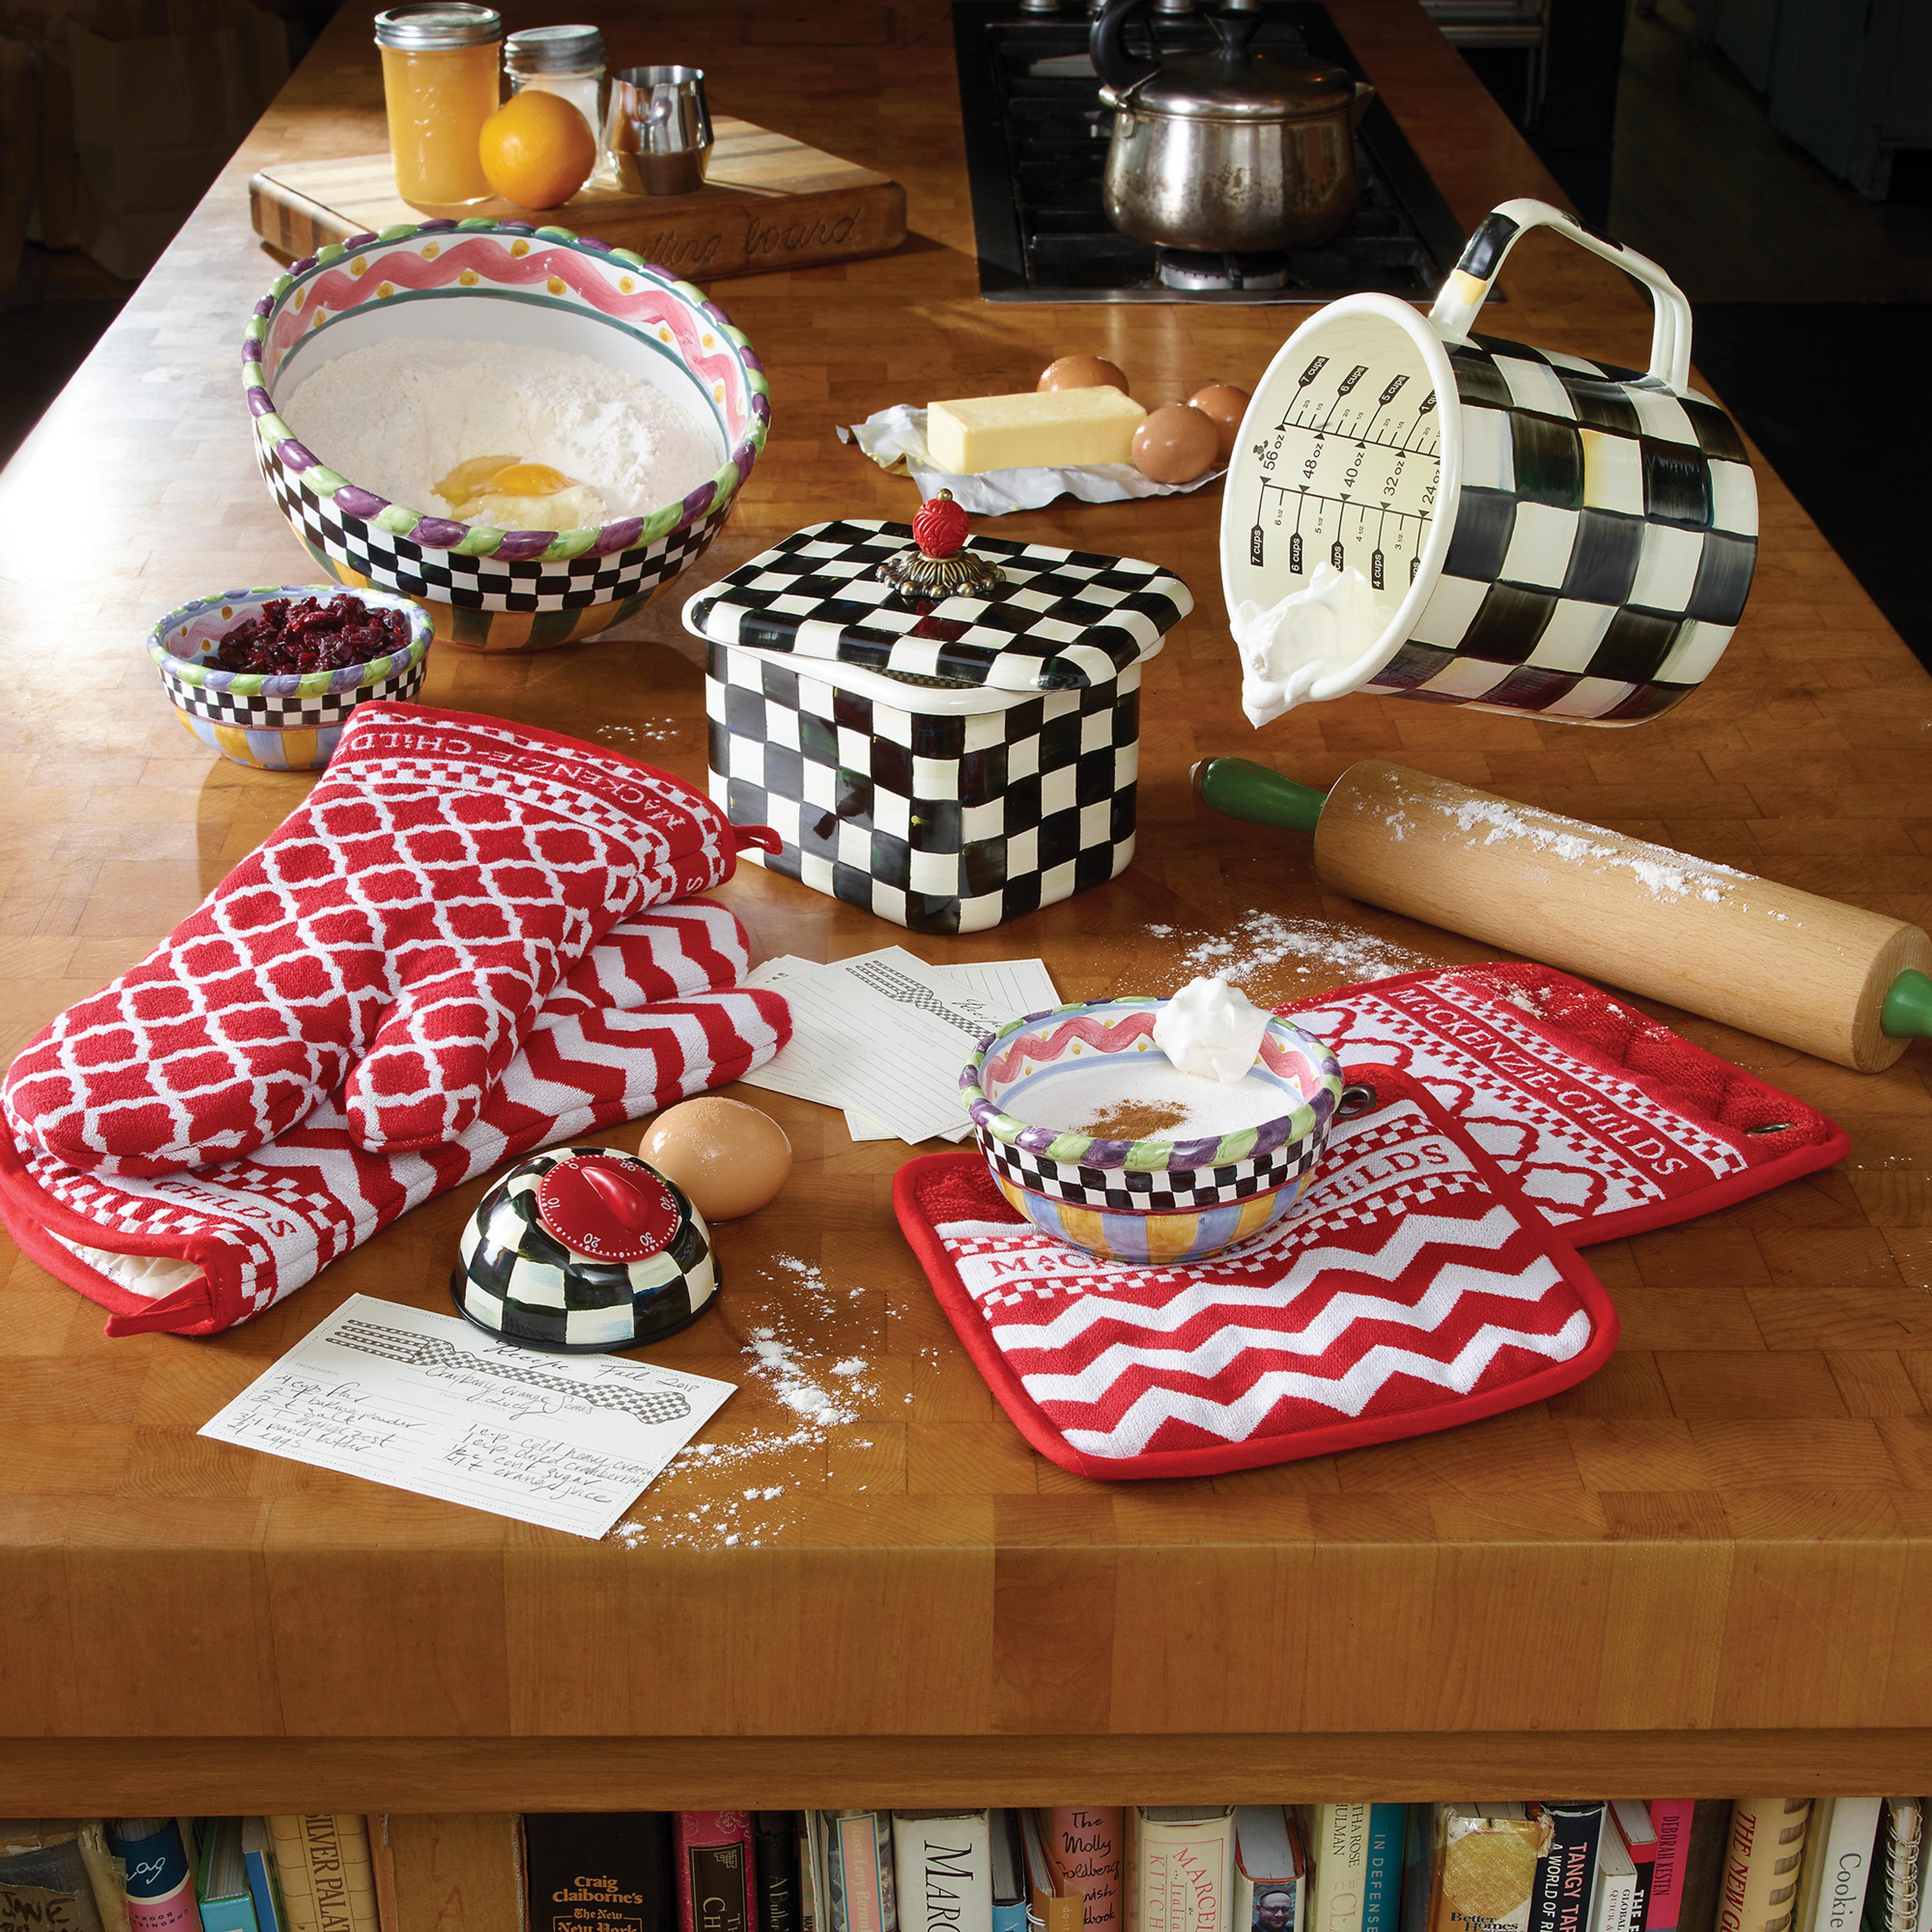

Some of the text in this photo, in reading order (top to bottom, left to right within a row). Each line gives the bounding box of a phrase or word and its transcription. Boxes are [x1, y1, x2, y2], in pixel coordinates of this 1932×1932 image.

[744, 206, 864, 256] board
[1308, 357, 1325, 375] cups
[1347, 367, 1365, 384] cups
[1388, 376, 1405, 393] cups
[1263, 434, 1285, 471] 56 oz
[1303, 443, 1323, 479] 48 oz
[1344, 452, 1365, 488] 40 oz
[1383, 461, 1405, 496] 32 oz
[1422, 486, 1437, 505] 24
[1254, 530, 1262, 554] cups
[1293, 538, 1301, 562] cups
[1374, 554, 1383, 578] cups
[547, 1197, 560, 1209] 10
[659, 1196, 672, 1210] 40
[583, 1233, 601, 1248] 20
[639, 1232, 656, 1247] 30
[1072, 1811, 1103, 1828] The
[851, 1825, 866, 1855] Rose
[1063, 1832, 1112, 1858] Molly
[1374, 1834, 1386, 1850] IN
[1732, 1809, 1757, 1858] THE
[1348, 1835, 1362, 1868] ROSE
[1653, 1816, 1680, 1896] DEBORAH KESTEN
[851, 1859, 868, 1888] Levy
[1544, 1855, 1562, 1899] WORLD
[1564, 1842, 1587, 1899] TANGY
[574, 1875, 618, 1893] Craig
[1725, 1855, 1749, 1913] NEW
[1830, 1853, 1862, 1929] Cookie
[574, 1908, 623, 1920] The New
[1450, 1912, 1497, 1924] Better
[1542, 1902, 1557, 1918] OF
[1464, 1921, 1519, 1932] Homes
